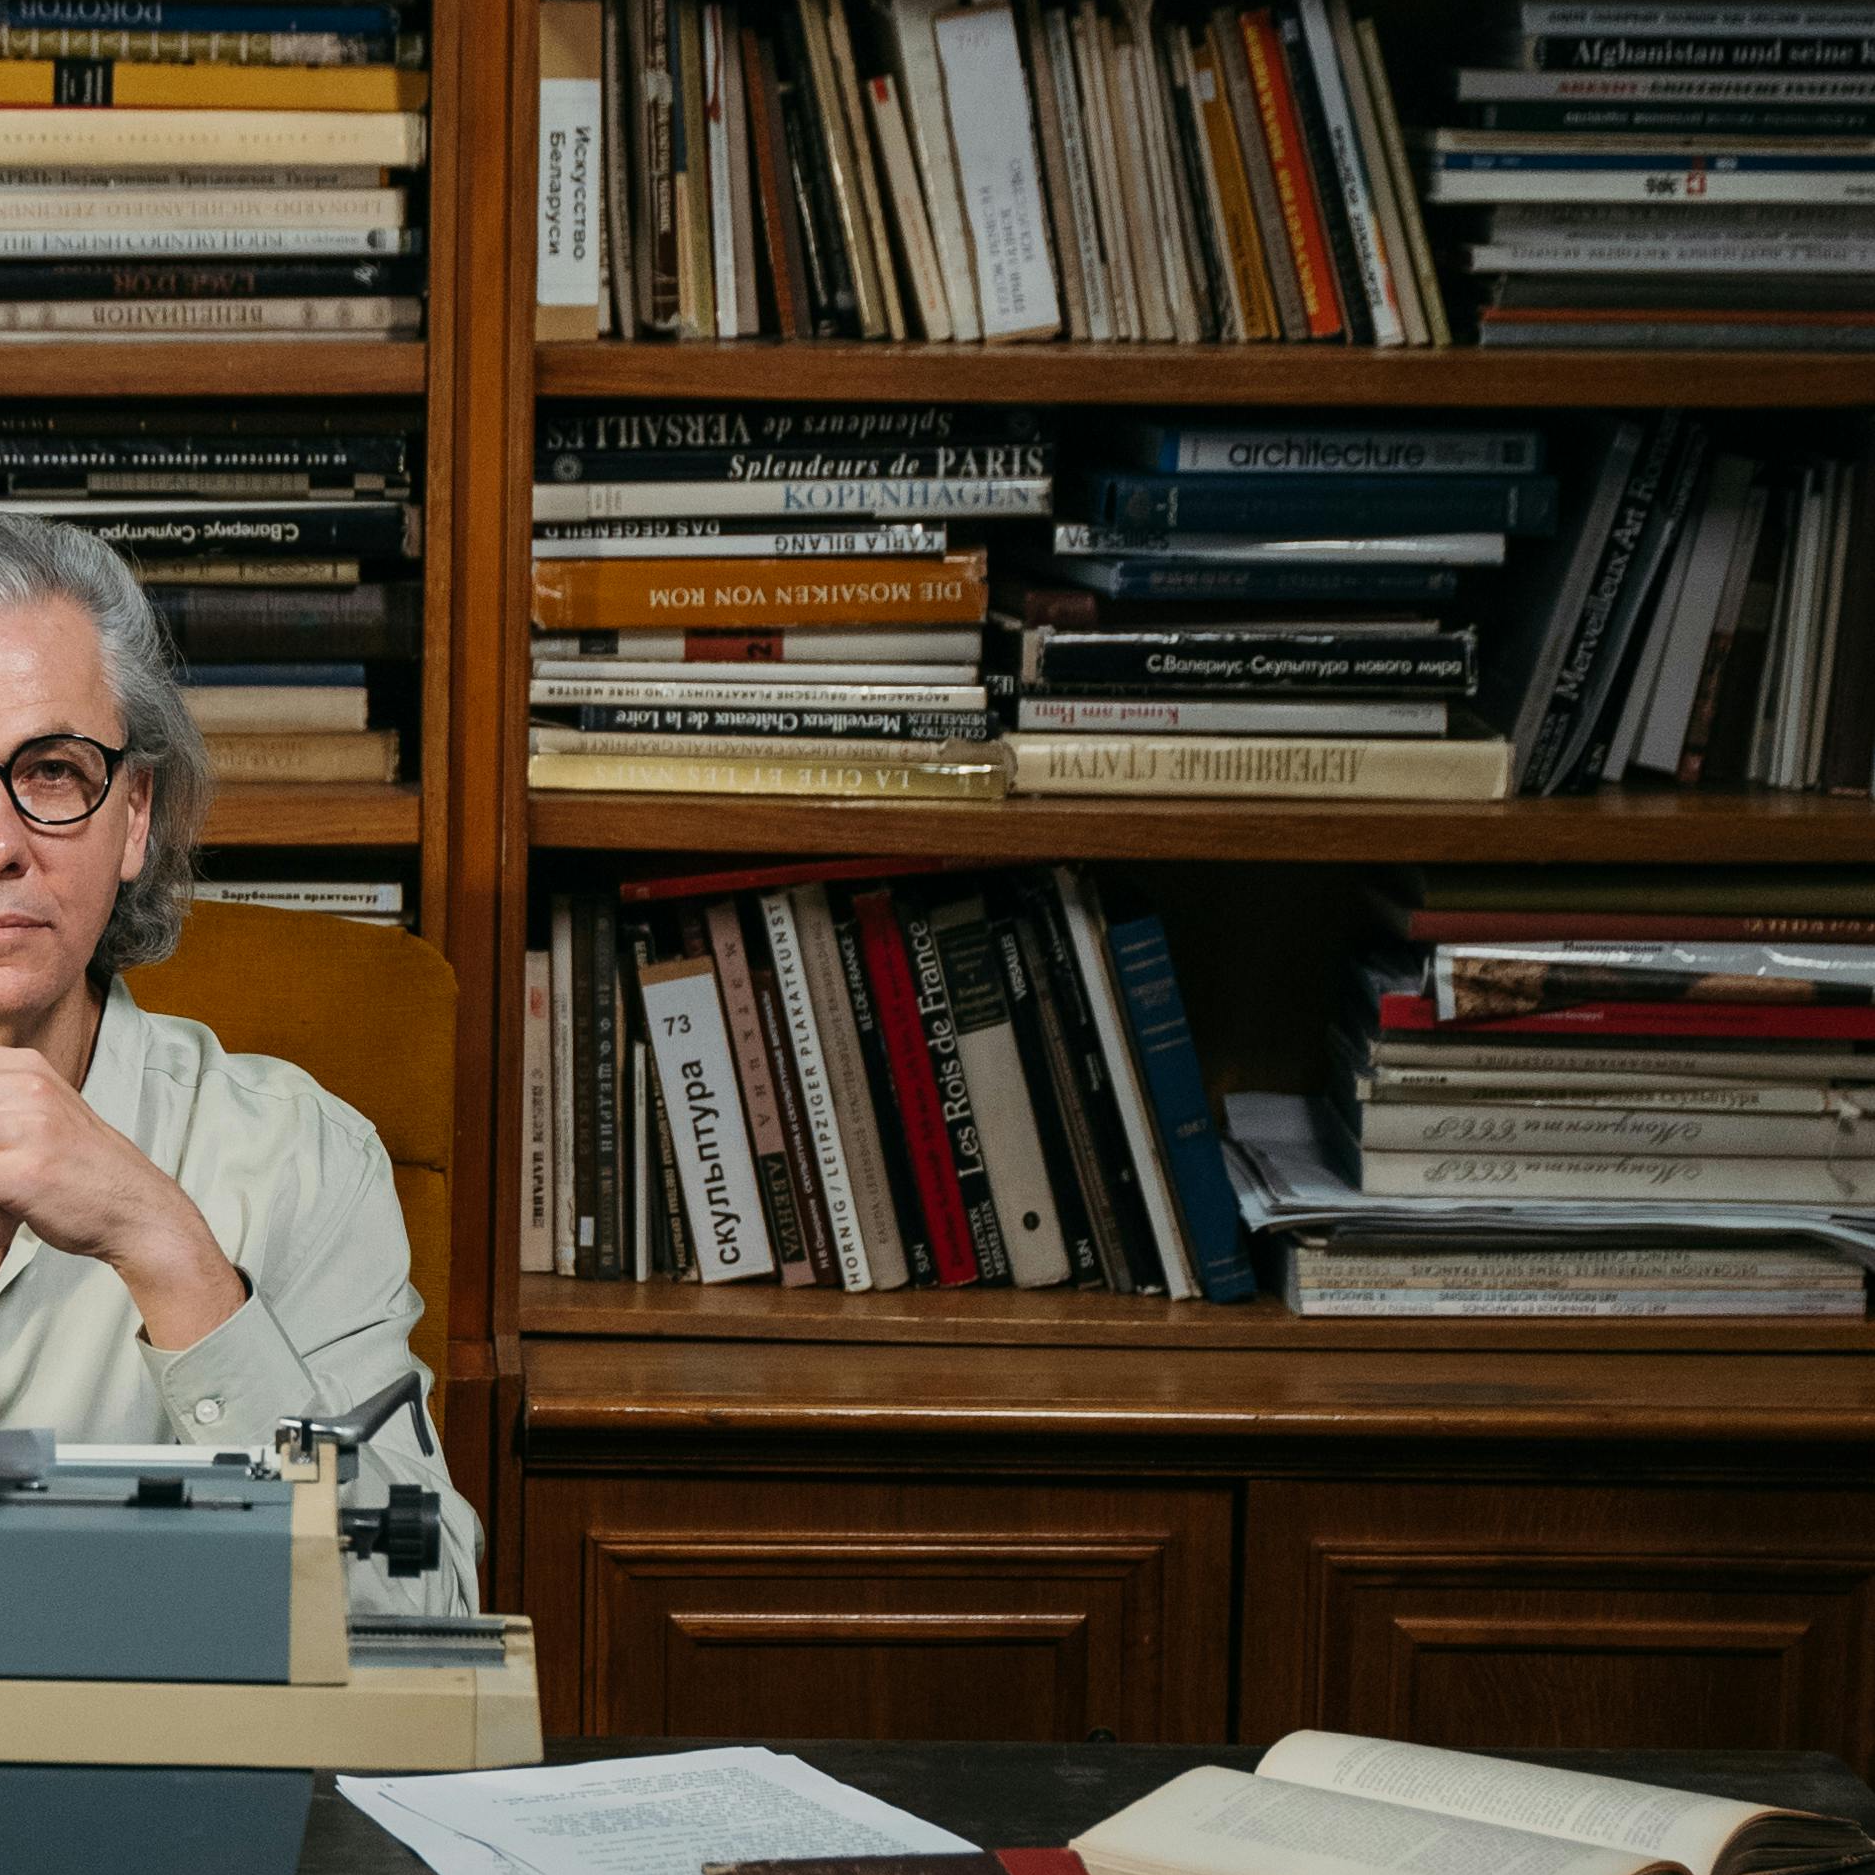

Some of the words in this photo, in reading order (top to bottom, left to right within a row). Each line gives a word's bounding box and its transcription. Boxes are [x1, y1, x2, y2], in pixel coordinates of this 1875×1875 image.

[1574, 38, 1725, 69] Afghanistan
[1731, 39, 1782, 65] und
[1788, 42, 1855, 66] seine
[548, 128, 568, 257] Беларуси
[572, 124, 592, 263] Искусство
[546, 413, 752, 450] VERSAILLES
[761, 412, 798, 436] de
[802, 409, 955, 438] Splendeurs
[727, 453, 881, 482] Splendeurs
[889, 453, 921, 476] de
[933, 445, 1047, 479] PARIS
[1227, 437, 1426, 470] architecture
[783, 480, 1032, 513] KOPENHAGEN
[675, 519, 721, 537] DAS
[867, 531, 937, 553] KARLA
[774, 534, 857, 553] BILANG
[648, 588, 707, 608] ROM
[714, 587, 771, 607] VON
[776, 584, 912, 605] MOSAIKEN
[921, 582, 964, 601] DIE
[1145, 653, 1244, 676] С.Валериус
[1250, 656, 1350, 678] Скульптура
[1354, 658, 1413, 675] нового
[1417, 659, 1463, 677] мира
[616, 708, 661, 726] Loire
[666, 710, 683, 727] la
[686, 710, 710, 728] de
[721, 711, 801, 732] Châteaux
[801, 715, 901, 734] Merveilleux
[1120, 705, 1180, 725] Kunst
[306, 891, 380, 907] архитектур
[768, 901, 816, 1055] PLAKATKUNST
[909, 921, 948, 1017] France
[998, 931, 1028, 1002] VERSAILLES
[662, 1013, 694, 1037] 73
[929, 1019, 958, 1059] de
[942, 1060, 972, 1125] Rois
[803, 1066, 840, 1177] LEIPZIGER
[681, 1058, 742, 1266] скульптура
[958, 1125, 985, 1179] Les
[835, 1199, 863, 1285] HORNIG
[1076, 1237, 1094, 1268] SUN
